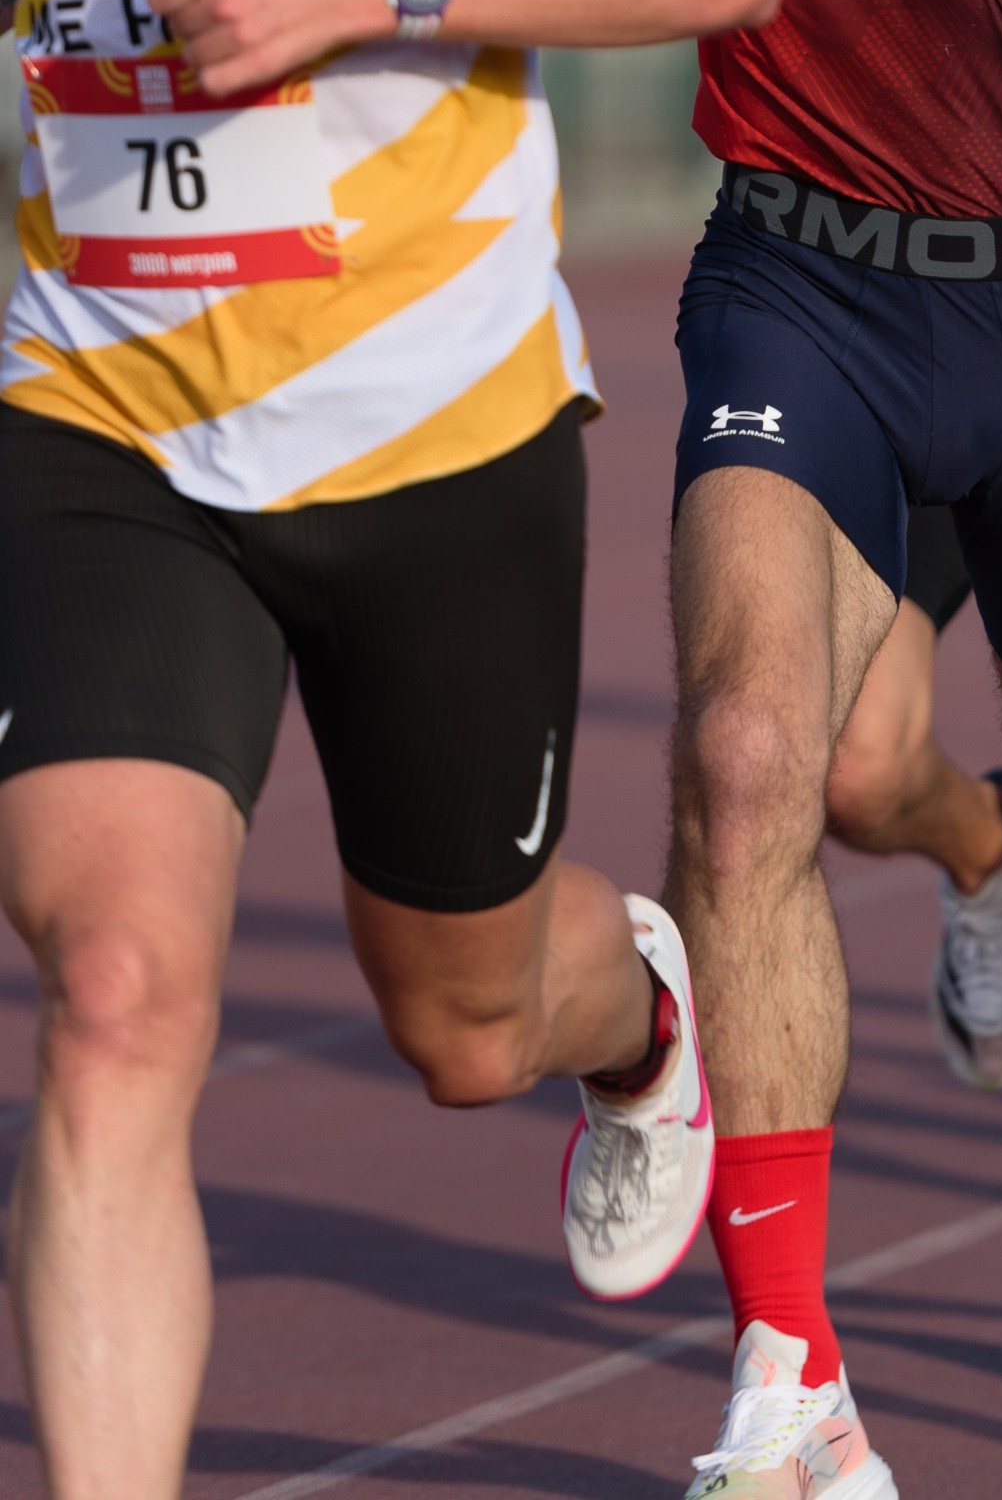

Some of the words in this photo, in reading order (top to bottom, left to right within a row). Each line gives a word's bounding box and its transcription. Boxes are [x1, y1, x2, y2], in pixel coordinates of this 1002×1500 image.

[125, 137, 207, 212] 76
[128, 251, 169, 277] 3000
[169, 250, 238, 277] метров
[702, 428, 738, 442] UNDER
[738, 428, 786, 445] ARMOUR
